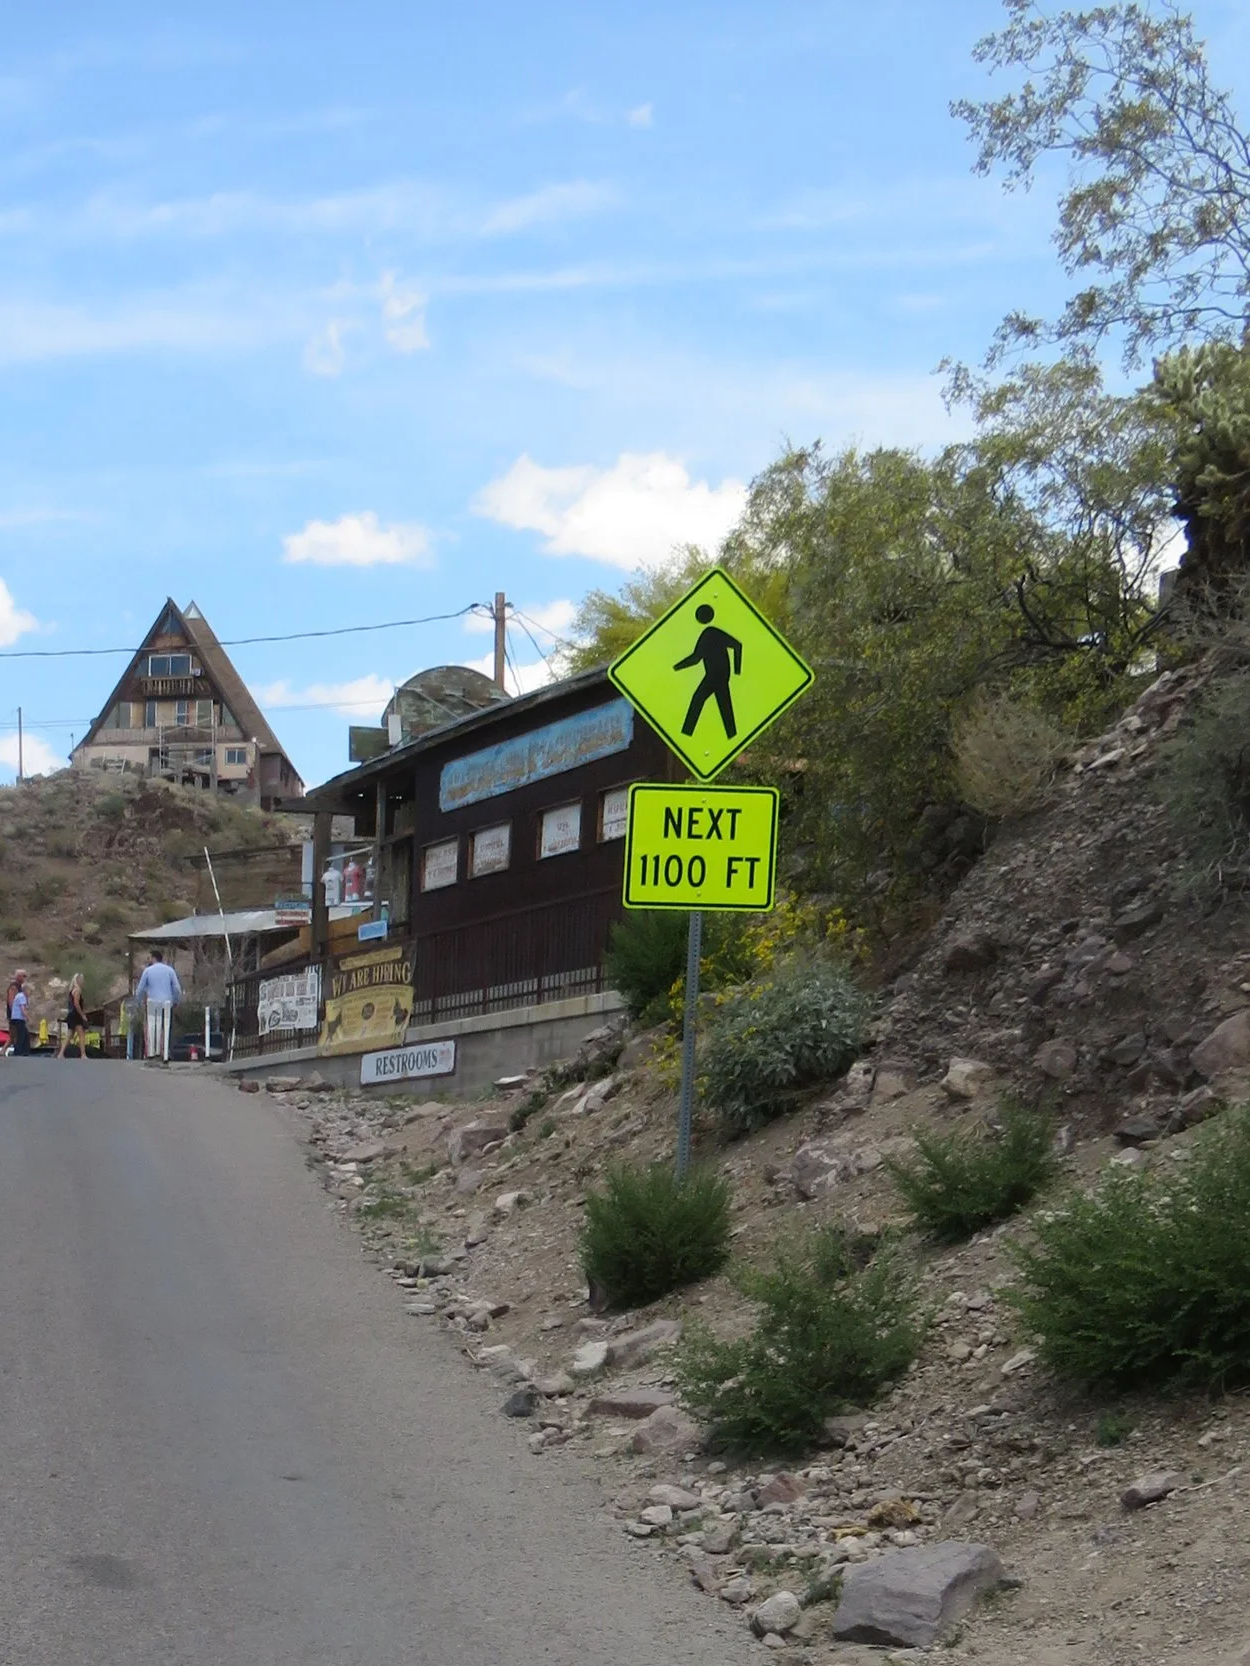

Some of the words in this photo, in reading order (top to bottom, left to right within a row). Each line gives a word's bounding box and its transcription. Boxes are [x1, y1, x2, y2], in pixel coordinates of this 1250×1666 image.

[663, 806, 742, 840] NEXT
[640, 854, 706, 888] 1100
[726, 856, 761, 889] FT
[350, 967, 370, 990] ARE
[372, 961, 411, 984] HIRING
[375, 1048, 438, 1076] RESTROOMS
